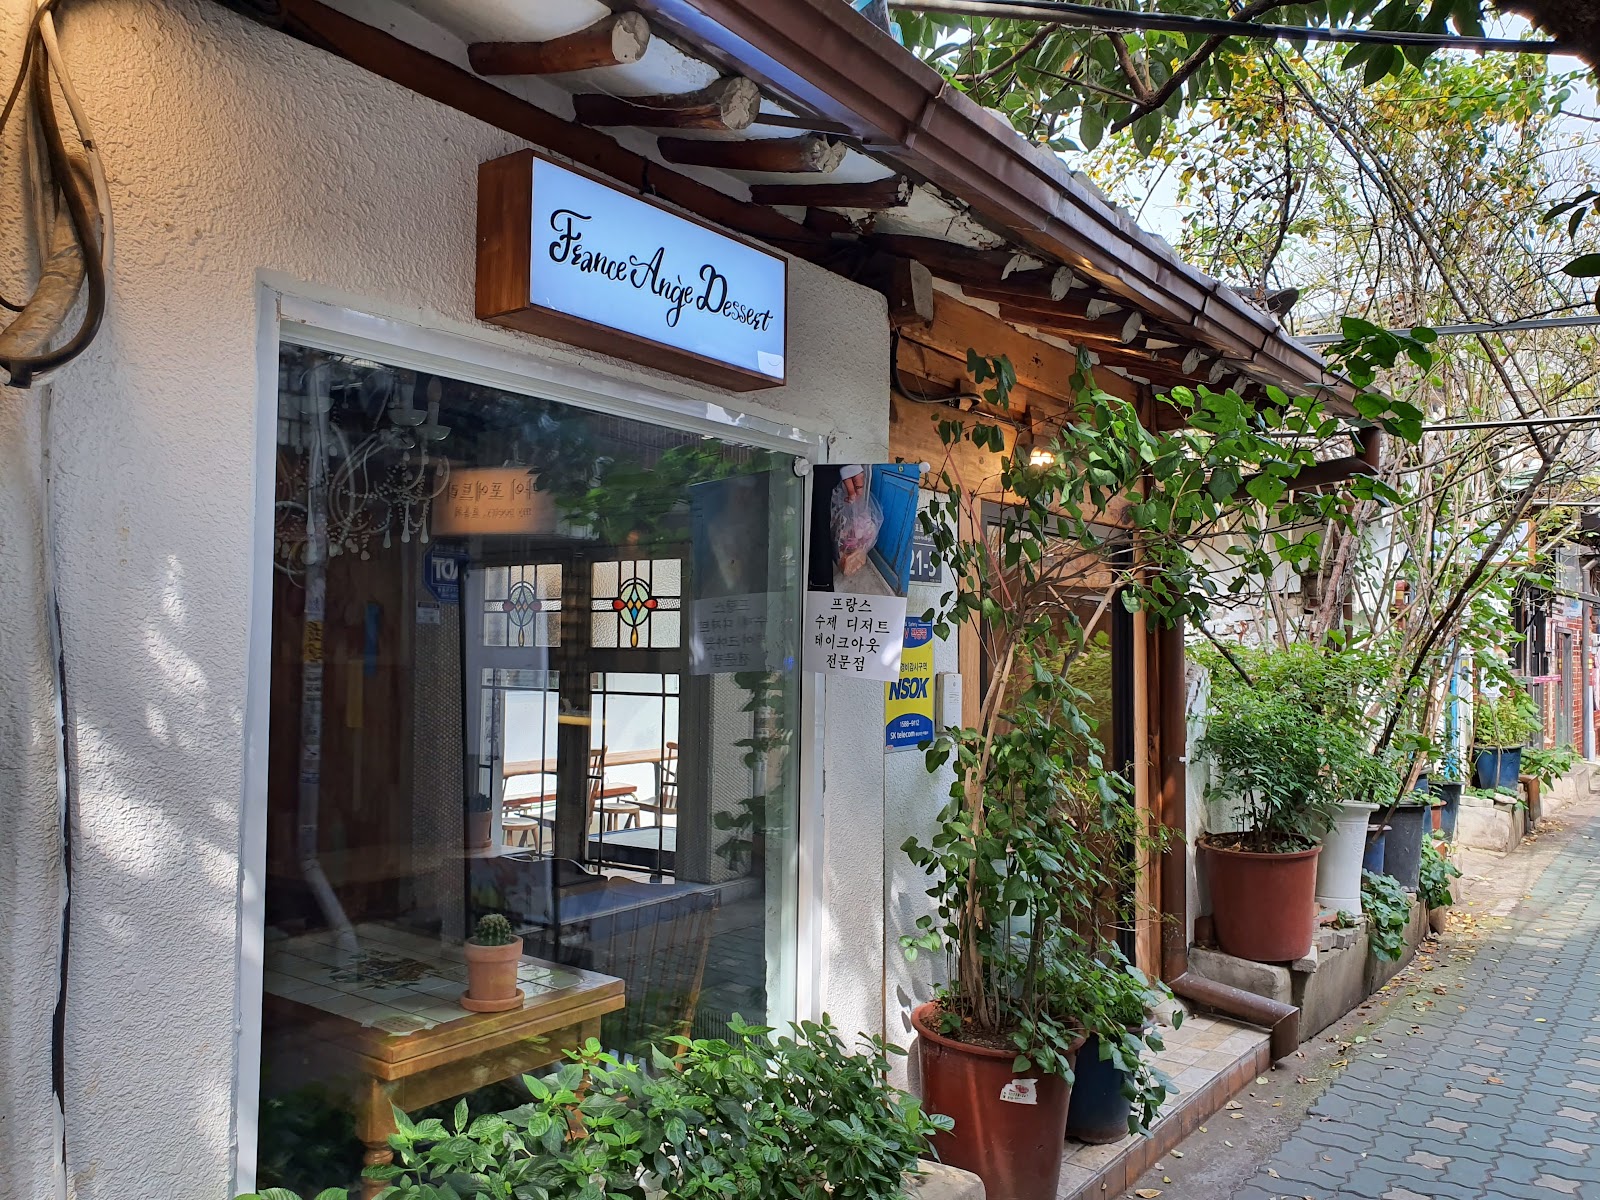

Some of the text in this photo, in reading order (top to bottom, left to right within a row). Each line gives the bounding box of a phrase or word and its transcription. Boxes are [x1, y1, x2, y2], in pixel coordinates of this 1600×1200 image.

[549, 208, 627, 281] France
[696, 264, 773, 331] Dessert
[830, 597, 872, 613] 프랑스
[815, 614, 890, 634] 수제 디저트
[815, 634, 880, 654] 테이크아웃
[826, 654, 866, 672] 전문점
[888, 677, 930, 701] NSOK
[890, 731, 897, 740] SK
[897, 730, 915, 739] telecom
